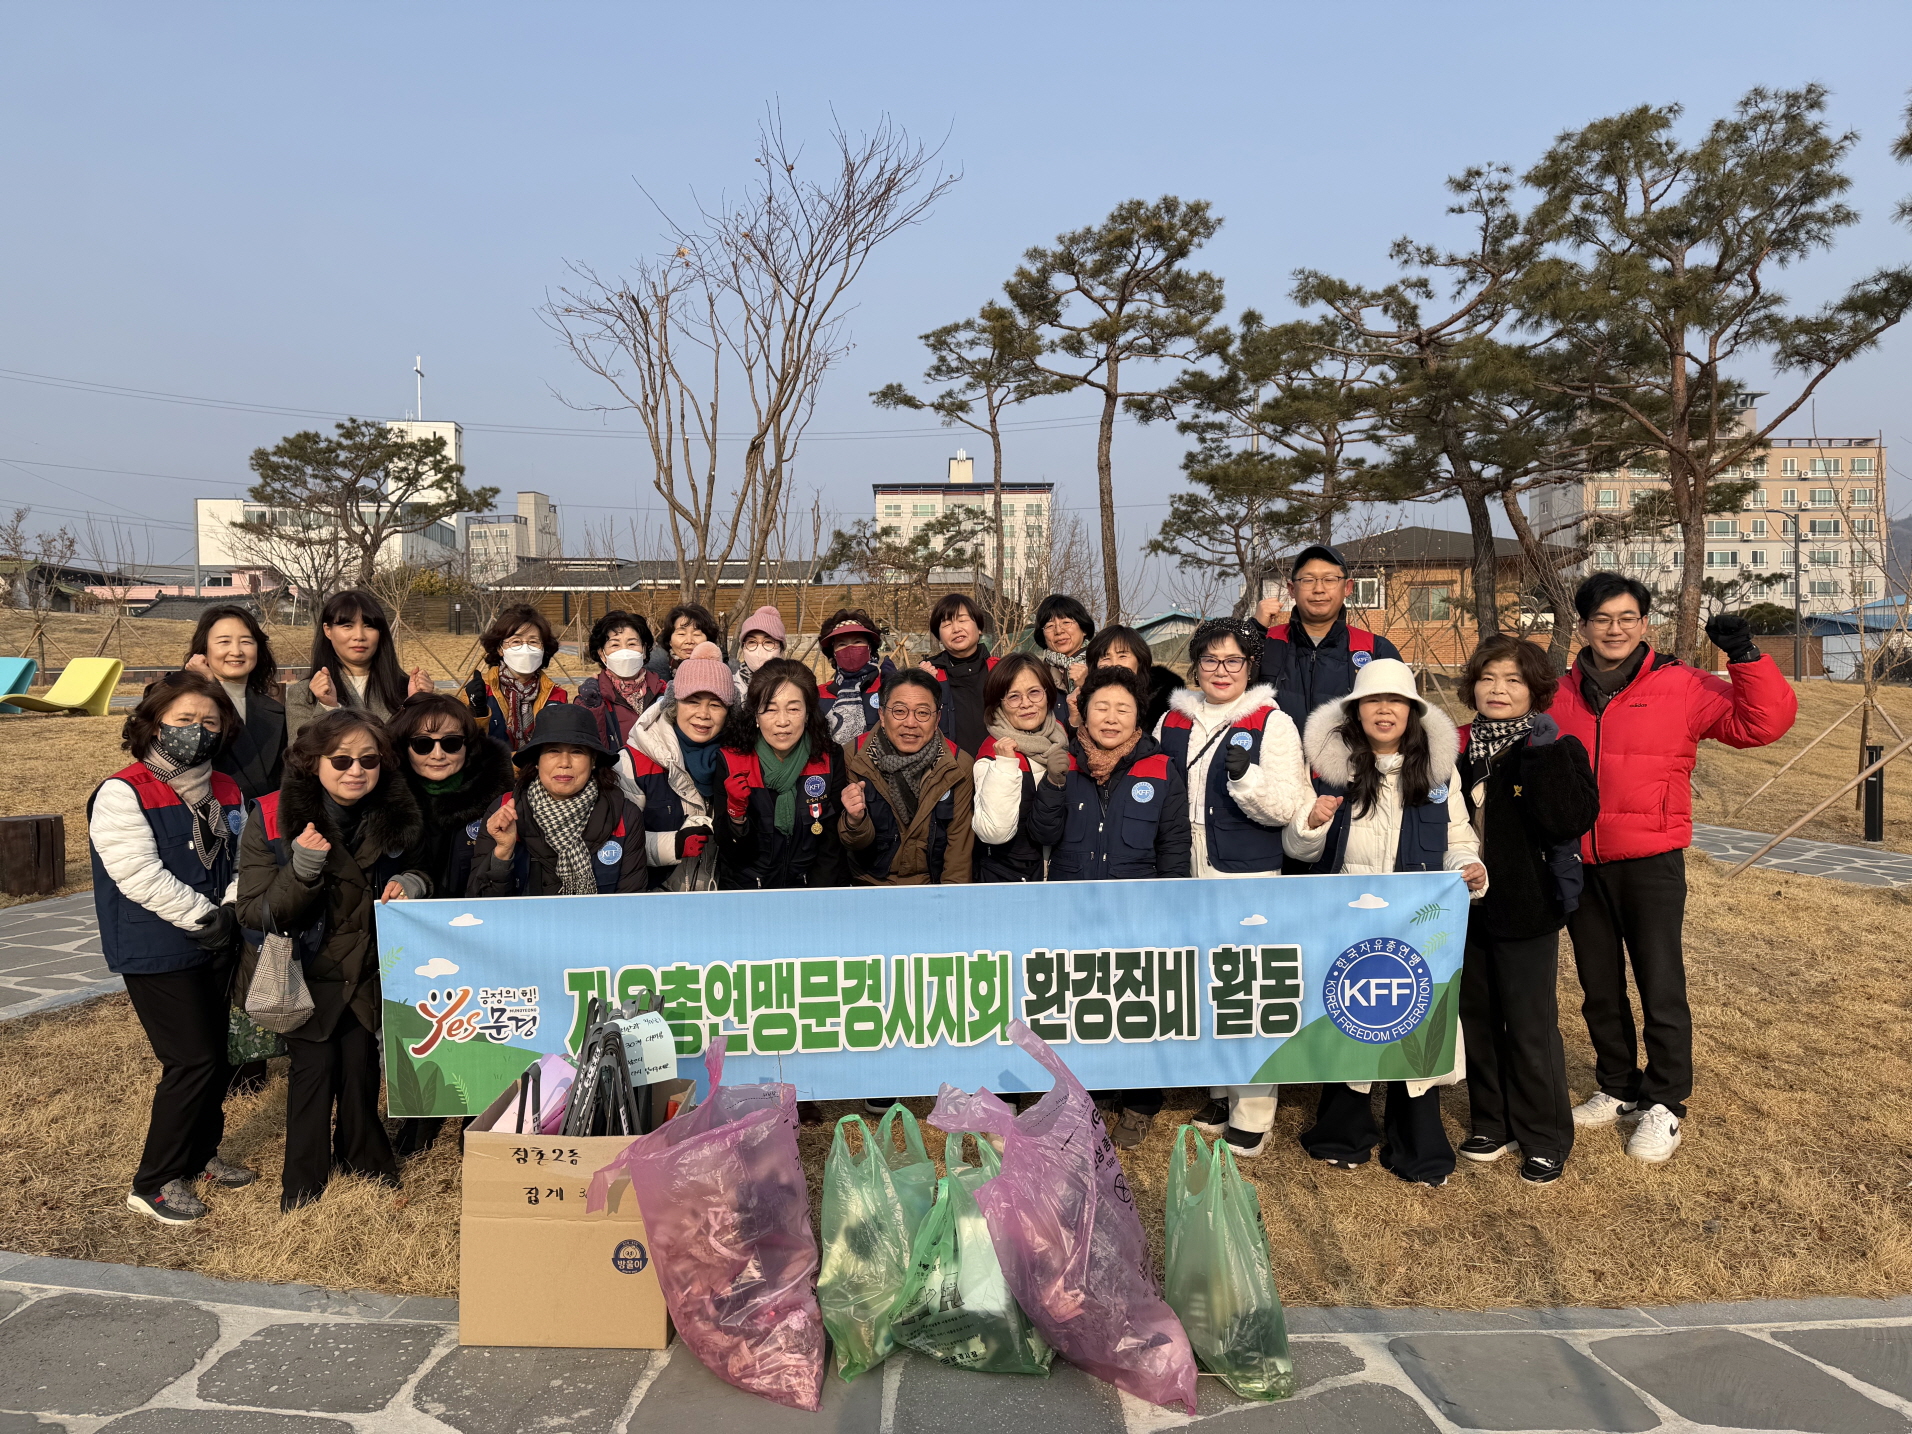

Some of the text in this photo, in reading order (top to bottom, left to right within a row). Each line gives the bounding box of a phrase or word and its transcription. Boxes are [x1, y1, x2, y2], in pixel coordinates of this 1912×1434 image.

[1335, 938, 1422, 970] 한국자유총연맹
[480, 989, 516, 1005] 긍정의
[1024, 946, 1197, 1041] 환경정비
[1210, 946, 1301, 1037] 활동
[1325, 977, 1430, 1042] KOREA FREEDOM FEDERATION
[1343, 978, 1413, 1006] KFF
[411, 988, 481, 1056] Yes
[478, 1006, 538, 1041] 문경
